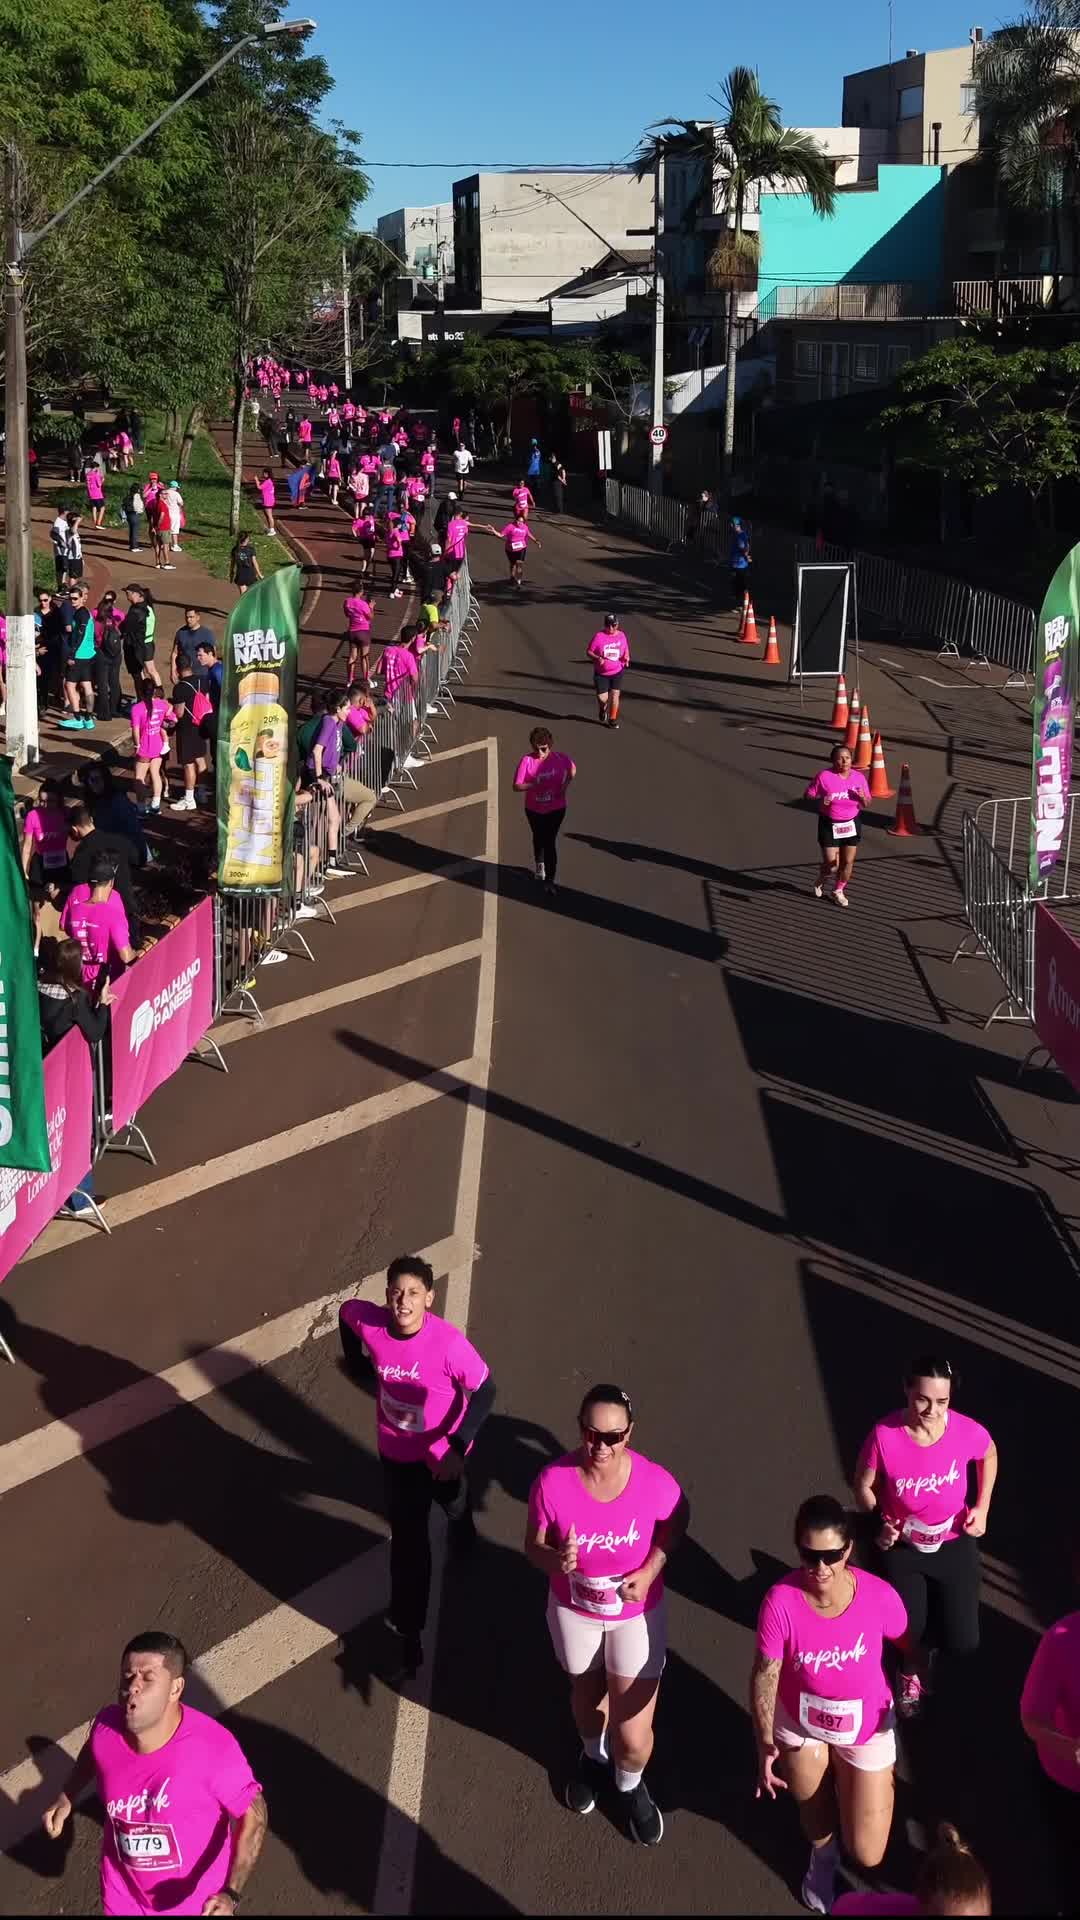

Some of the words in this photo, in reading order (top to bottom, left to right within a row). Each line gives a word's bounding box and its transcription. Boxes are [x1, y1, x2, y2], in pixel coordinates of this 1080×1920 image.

[233, 629, 278, 648] BEBA
[234, 642, 286, 665] NATU
[263, 715, 279, 724] 20%
[377, 1361, 421, 1381] opink
[896, 1459, 961, 1497] gopink
[577, 1519, 641, 1553] opink
[794, 1633, 868, 1675] gopink
[816, 1713, 843, 1729] 497
[124, 1836, 163, 1851] 1779
